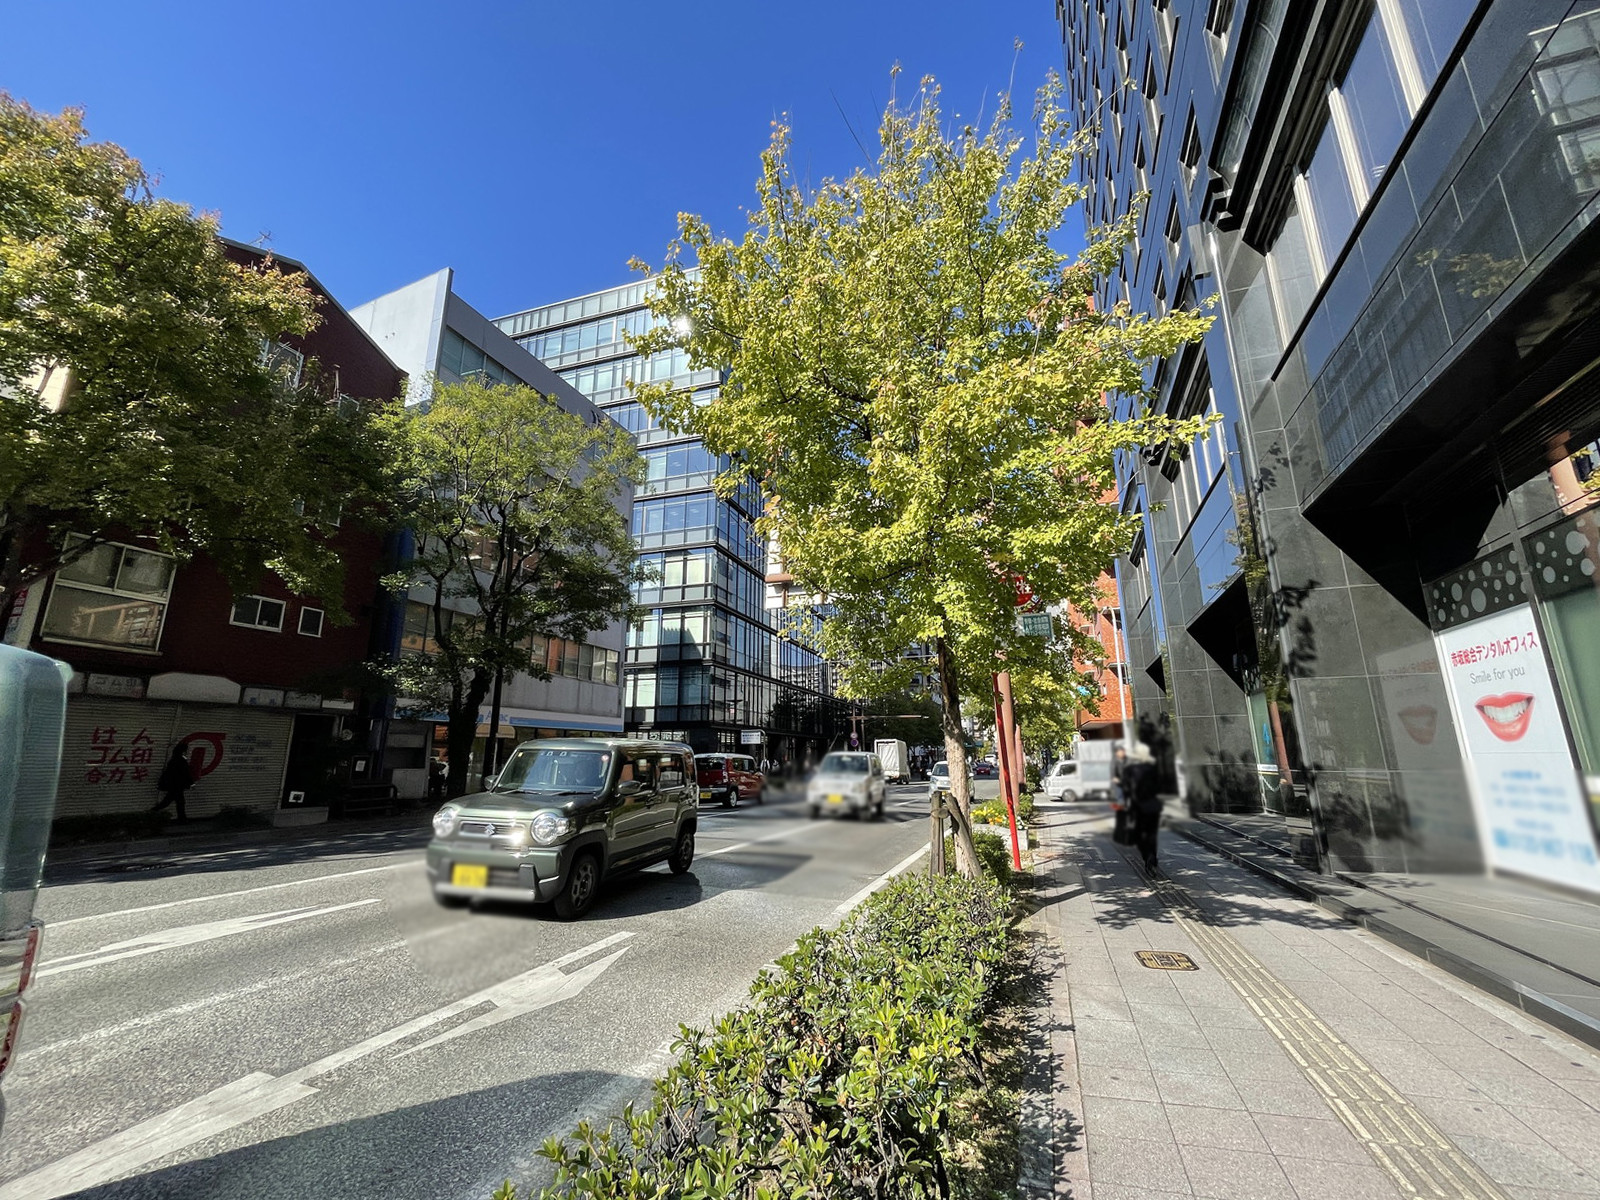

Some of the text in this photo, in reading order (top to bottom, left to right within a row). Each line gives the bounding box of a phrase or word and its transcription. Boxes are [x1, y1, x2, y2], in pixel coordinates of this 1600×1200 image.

[1450, 631, 1538, 668] 赤坂総合デンタルオフィス
[1469, 666, 1526, 685] Smile for you
[87, 745, 153, 764] ゴム印
